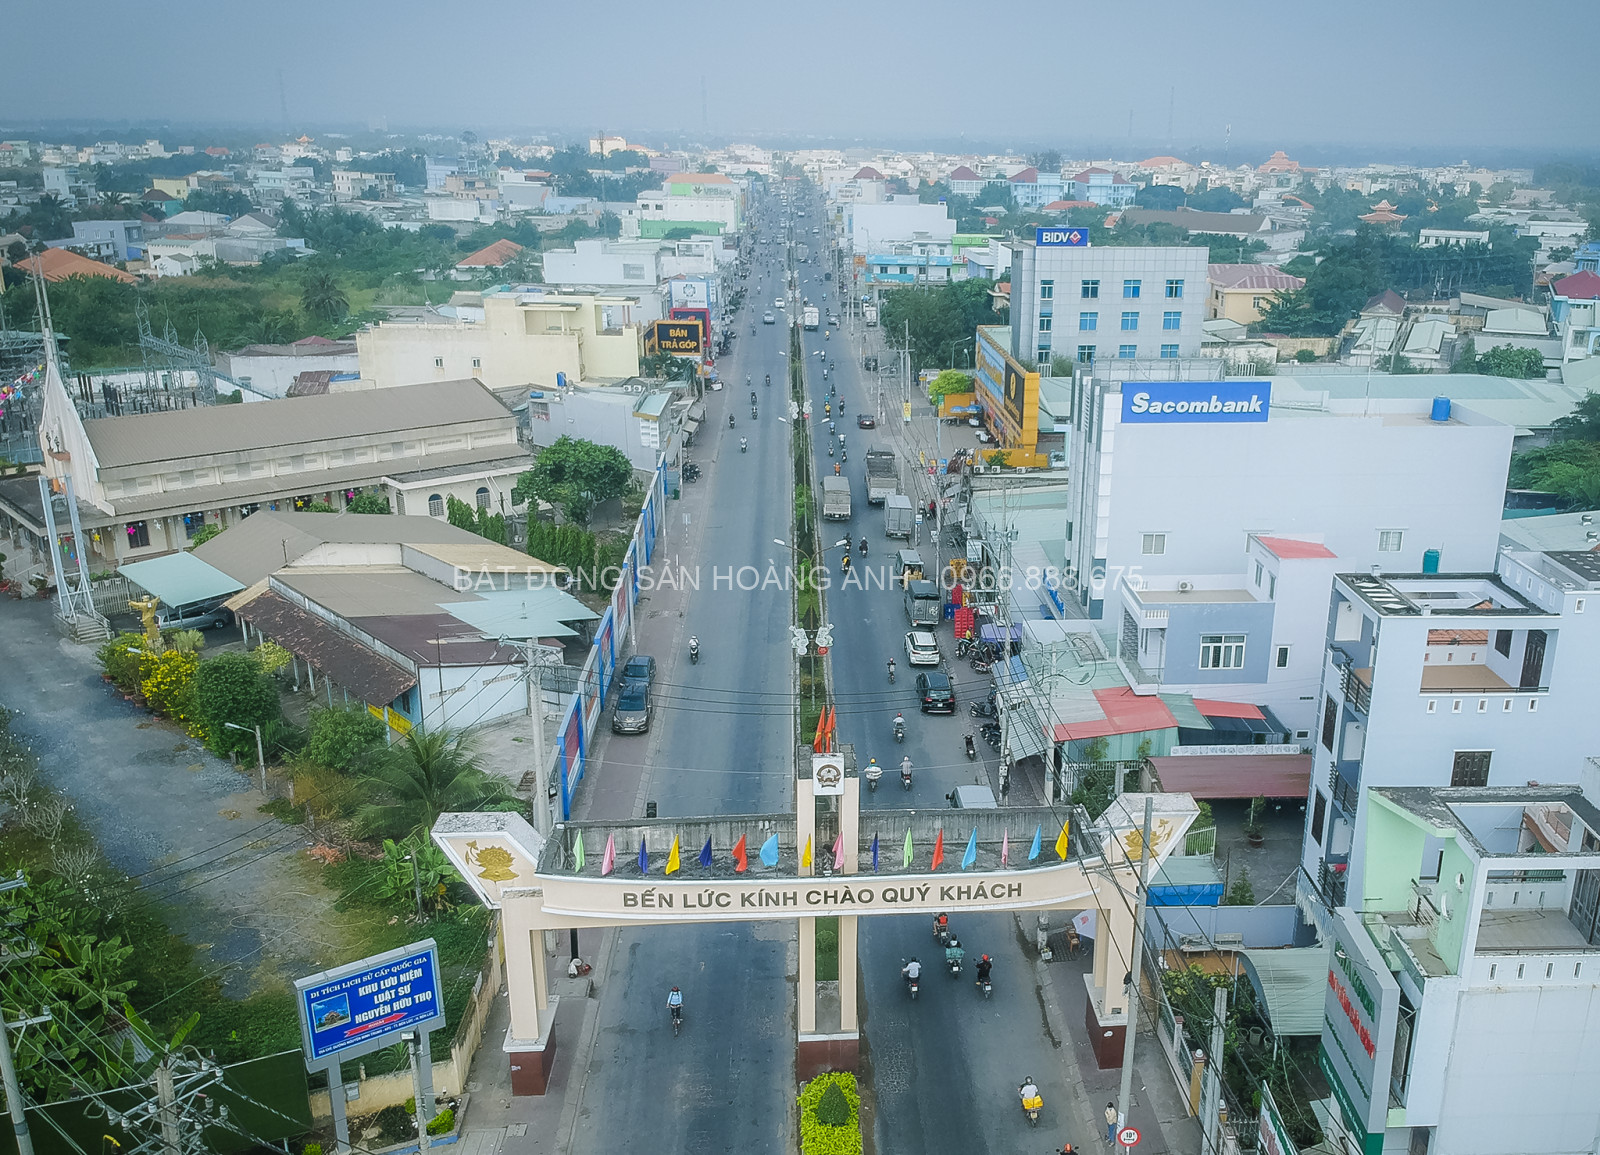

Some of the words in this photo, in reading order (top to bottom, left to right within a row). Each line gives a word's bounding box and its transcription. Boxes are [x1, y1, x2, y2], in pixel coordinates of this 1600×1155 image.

[1042, 231, 1069, 243] BIDV
[661, 339, 678, 349] TRẢ
[679, 340, 697, 349] GÓP
[669, 328, 688, 338] BÁN
[1131, 392, 1263, 414] Sacombank
[622, 887, 674, 908] BẾN
[683, 888, 732, 909] LỨC
[741, 887, 798, 908] KÍNH
[805, 885, 875, 905] CHÀO
[881, 884, 931, 904] QUÝ
[939, 882, 1023, 901] KHÁCH
[310, 990, 319, 998] DI
[320, 984, 340, 994] TÍCH
[342, 977, 360, 989] LỊCH
[362, 971, 373, 981] SỬ
[374, 967, 389, 978] CẤP
[391, 960, 411, 972] QUỐC
[413, 956, 426, 965] GIA
[358, 982, 378, 996] KHU
[380, 975, 397, 989] LƯU
[399, 968, 422, 983] NIỆM
[373, 988, 396, 1004] LUẬT
[397, 982, 411, 996] SƯ
[354, 1004, 390, 1024] NGUYỄN
[392, 996, 412, 1011] HỮU
[413, 991, 432, 1004] THỌ
